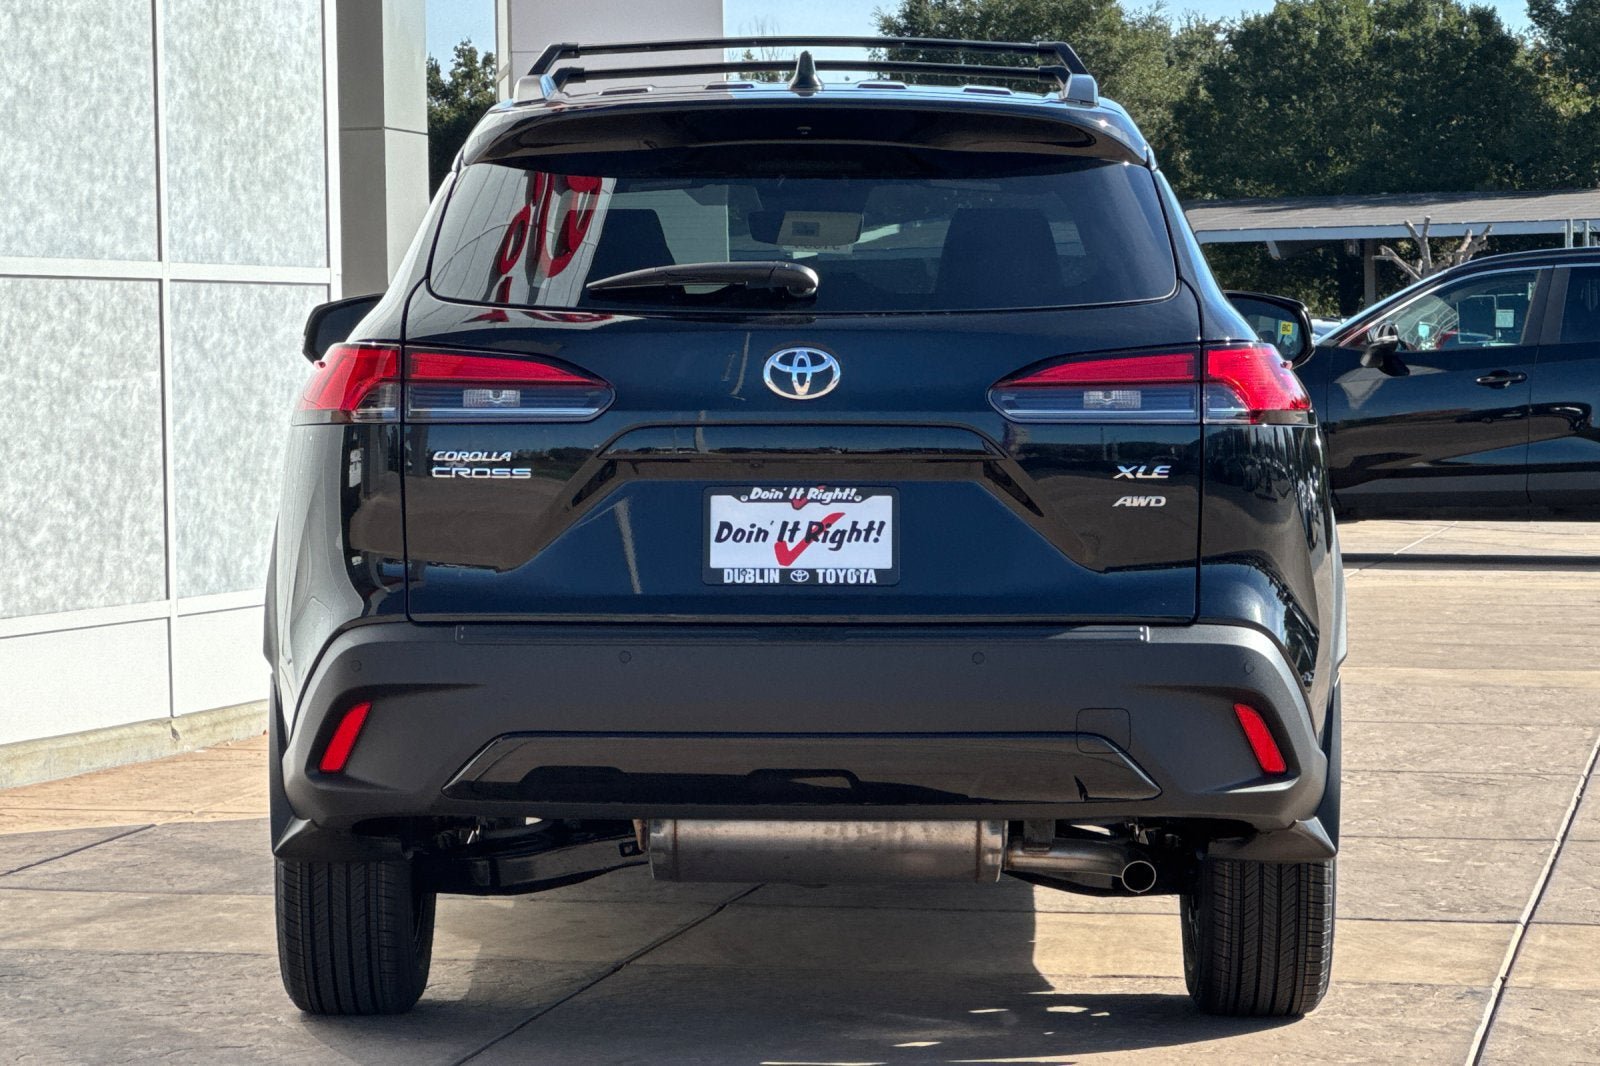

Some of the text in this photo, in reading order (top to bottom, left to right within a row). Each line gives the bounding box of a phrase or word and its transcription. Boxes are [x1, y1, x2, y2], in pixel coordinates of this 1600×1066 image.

[432, 451, 512, 462] COROLLA
[431, 467, 532, 479] CROSS
[1113, 465, 1172, 479] XLE
[750, 487, 857, 504] Doin' It Right!
[1112, 495, 1167, 508] AWD
[714, 520, 886, 551] Doin' It Right!
[723, 568, 877, 584] DUBLIN TOYOTA
